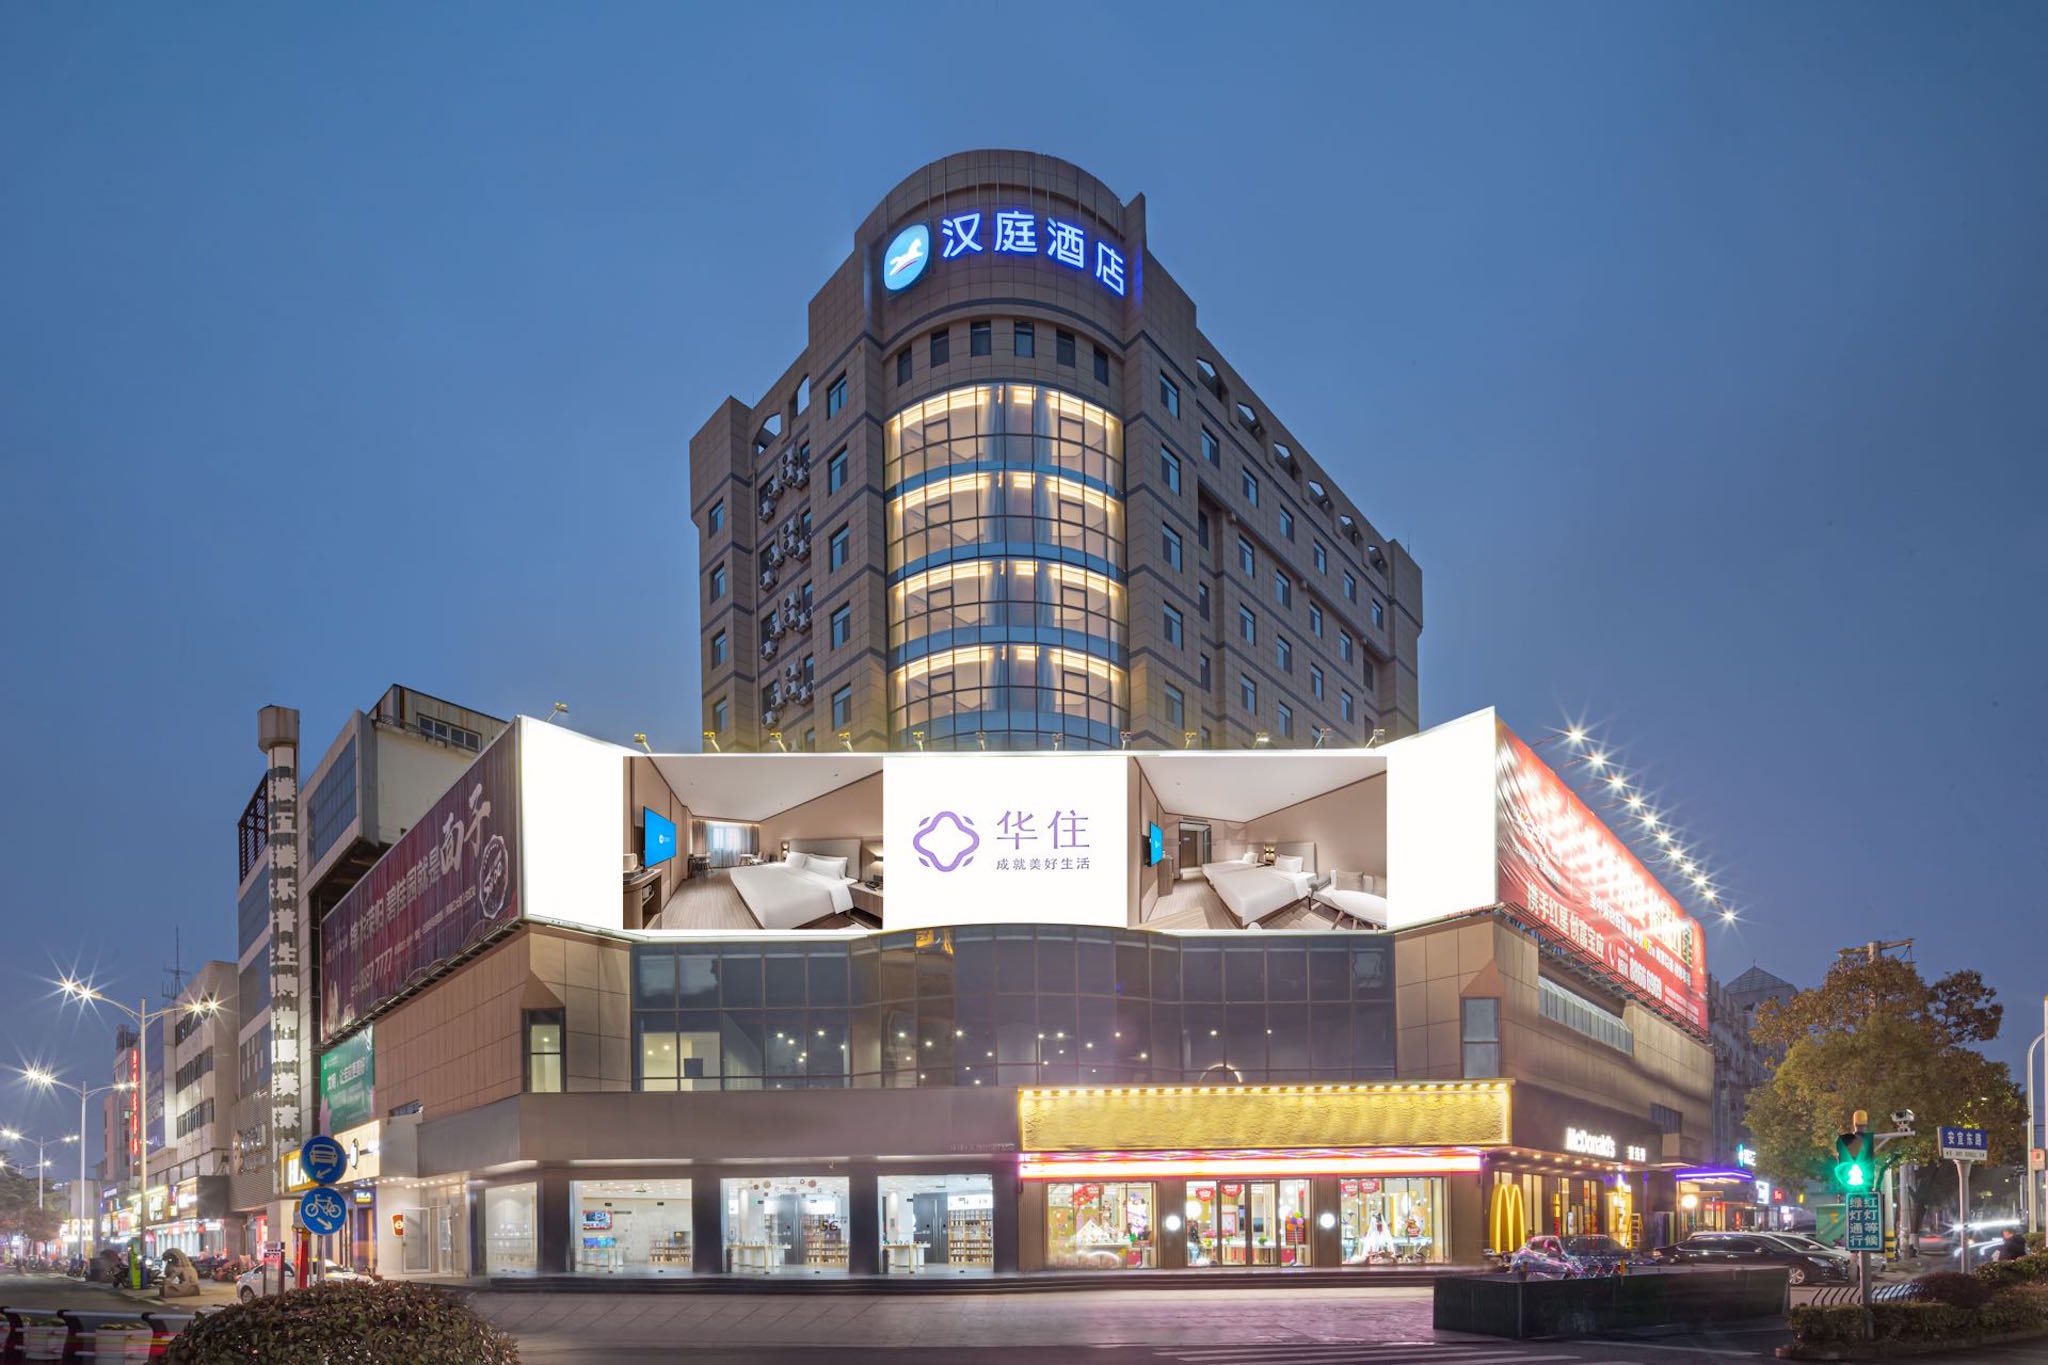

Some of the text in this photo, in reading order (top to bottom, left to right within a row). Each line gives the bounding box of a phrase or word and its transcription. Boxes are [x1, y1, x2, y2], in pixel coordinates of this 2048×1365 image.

[942, 211, 1125, 296] 汉庭酒店
[996, 810, 1090, 850] 华住
[996, 857, 1090, 871] 成就美好生活
[1947, 1131, 1982, 1146] 安宜东路
[1849, 1197, 1863, 1247] 绿灯通行
[1864, 1197, 1878, 1247] 红灯等候
